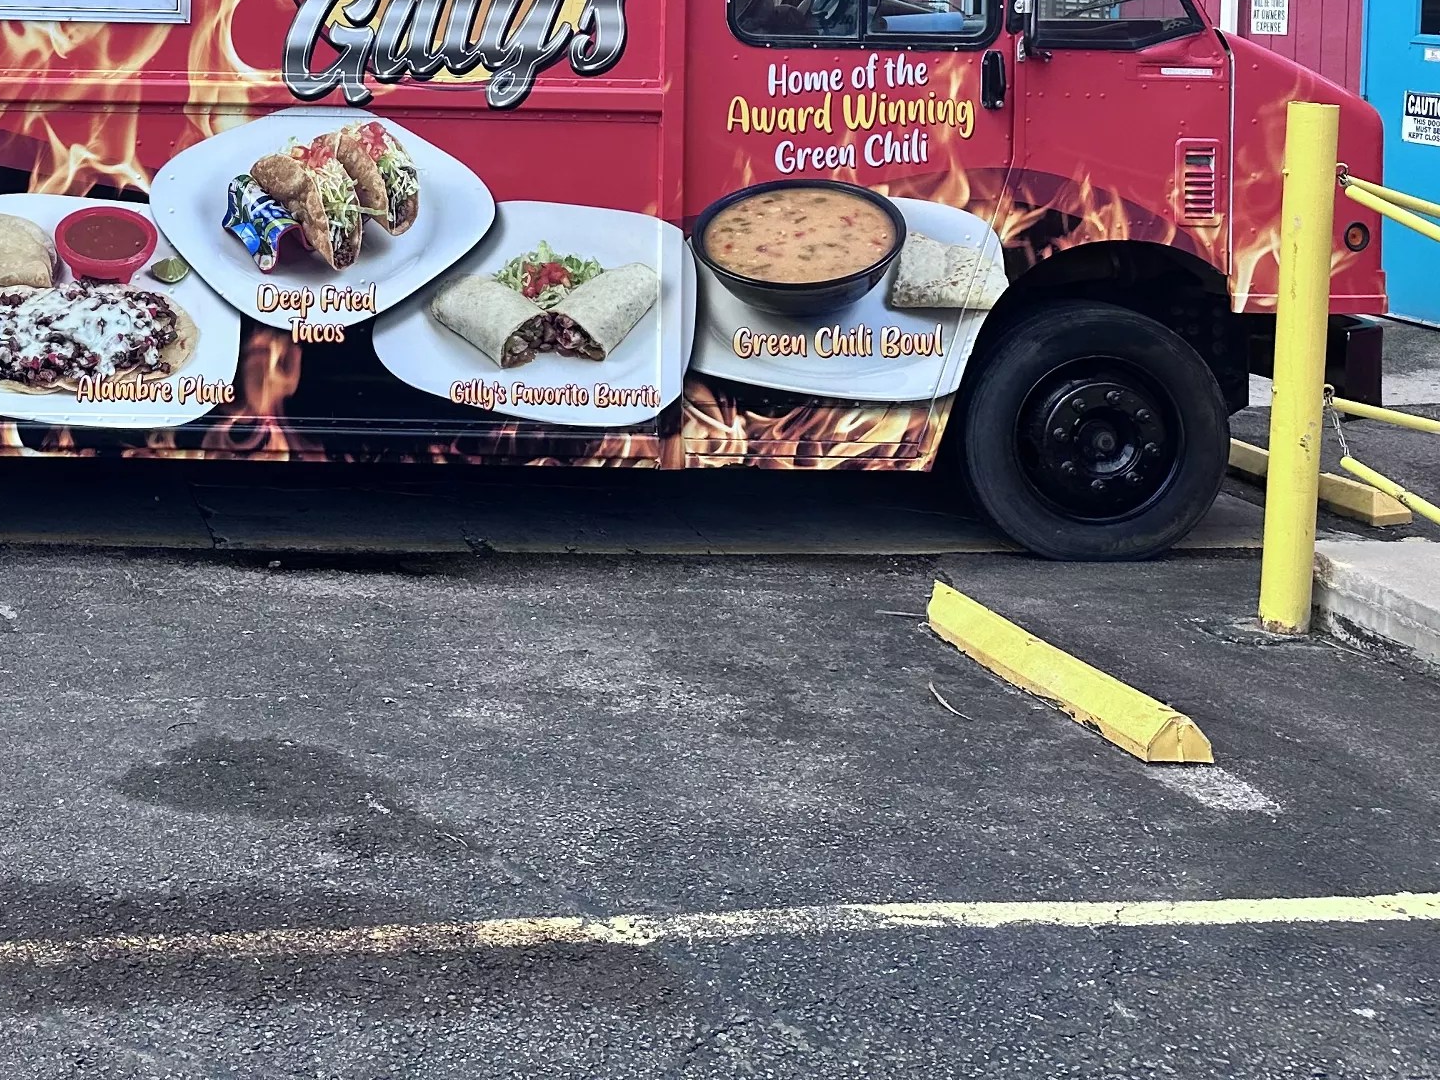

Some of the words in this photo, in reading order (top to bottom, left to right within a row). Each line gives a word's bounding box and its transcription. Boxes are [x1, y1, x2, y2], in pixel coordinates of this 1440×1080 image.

[1253, 10, 1259, 19] AT
[1256, 22, 1281, 32] EXPENSE
[768, 63, 843, 96] Home
[851, 55, 877, 89] of
[884, 53, 929, 87] the
[727, 92, 832, 133] Award
[843, 91, 976, 139] Winning
[775, 140, 856, 174] Green
[864, 129, 929, 166] Chili
[257, 284, 313, 317] Deep
[321, 282, 376, 312] Fried
[289, 318, 345, 344] Tacos
[733, 327, 806, 358] Green
[815, 324, 872, 357] Chili
[880, 324, 943, 358] Bowl
[77, 374, 172, 404] Alambre
[179, 377, 235, 405] Plate
[450, 379, 506, 410] Gilly's
